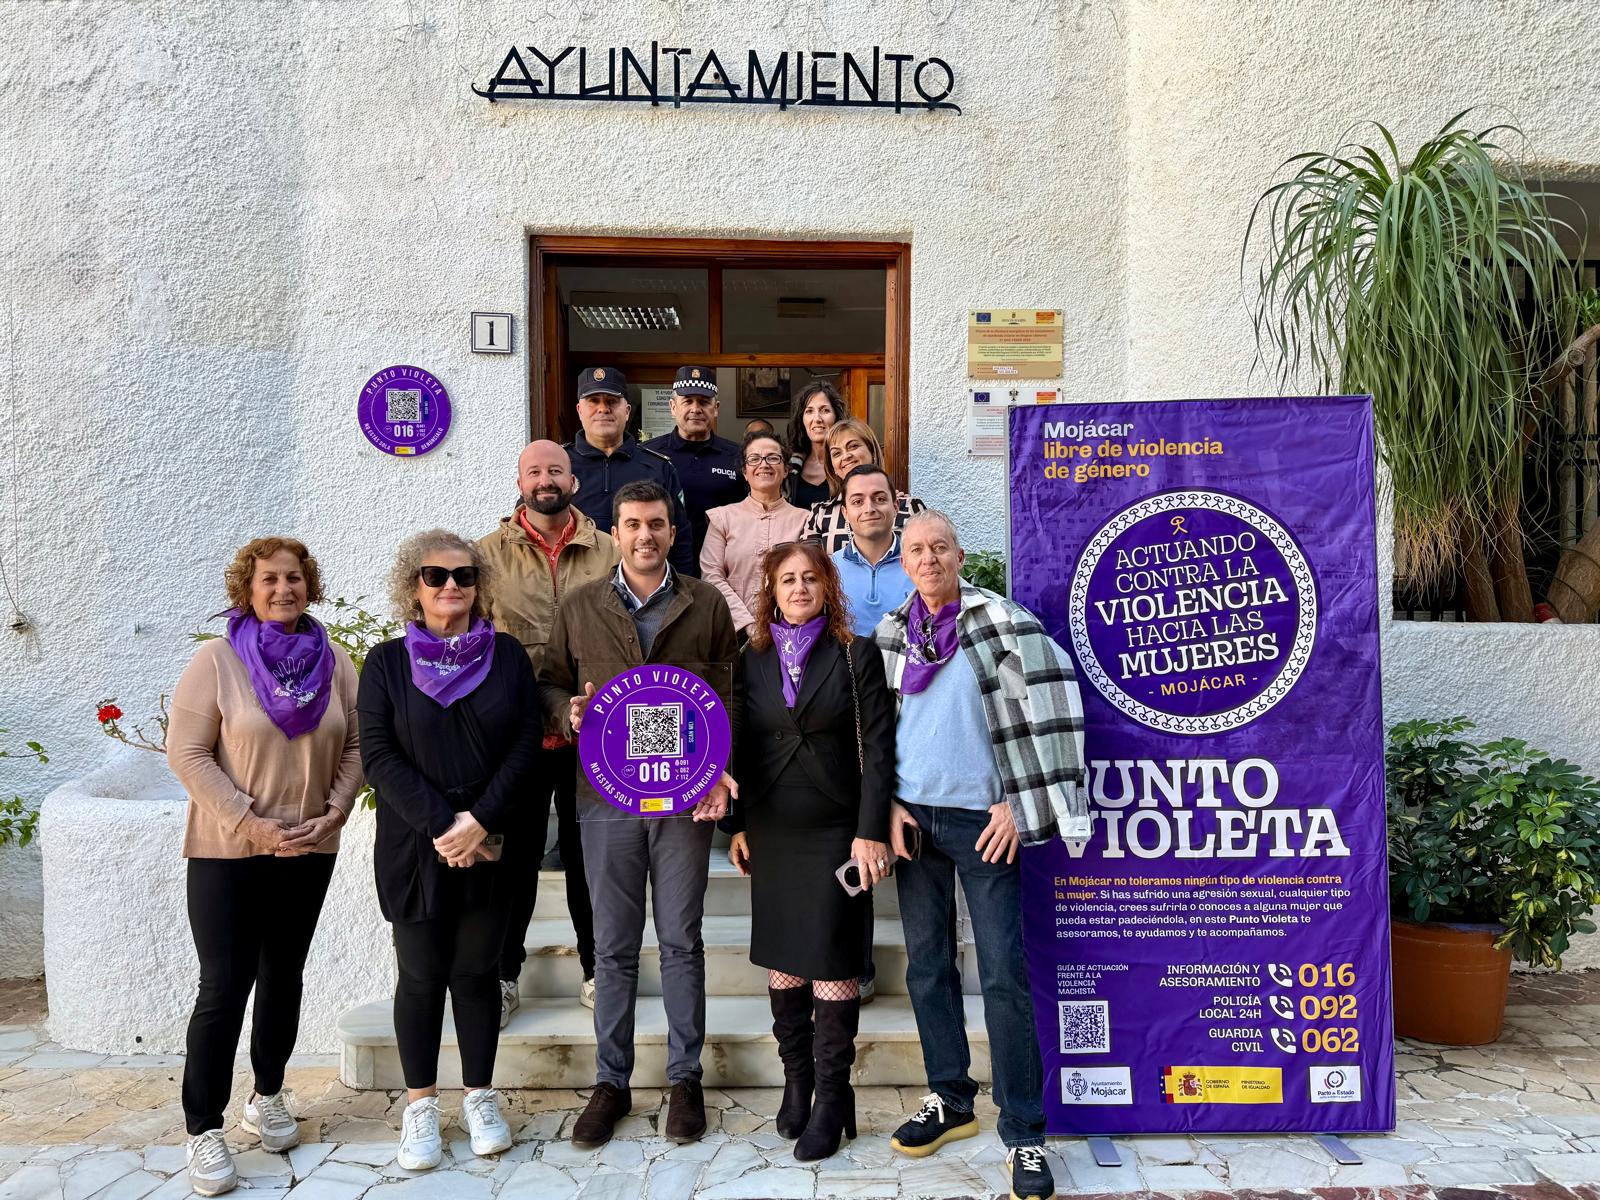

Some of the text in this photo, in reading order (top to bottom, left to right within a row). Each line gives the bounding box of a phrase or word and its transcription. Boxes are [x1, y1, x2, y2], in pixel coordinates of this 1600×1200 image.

[485, 41, 957, 112] AYUNTAMIENTO
[485, 321, 498, 346] 1
[366, 368, 442, 395] PUNTO VIOLETA
[394, 425, 414, 437] 016
[1044, 419, 1134, 441] Mojácar
[379, 440, 391, 451] SOLA
[1044, 437, 1223, 458] libre de violencia
[1044, 460, 1150, 483] de género
[1115, 532, 1256, 570] ACTUANDO
[1116, 556, 1260, 593] CONTRA LA
[1095, 577, 1288, 626] VIOLENCIA
[1126, 610, 1264, 648] HACIA LAS
[1118, 632, 1280, 679] MUJERES
[593, 670, 716, 714] PUNTO VIOLETA
[639, 761, 670, 782] 016
[590, 762, 599, 774] NO
[596, 774, 616, 795] ESTÁS
[614, 791, 633, 807] SOLA
[682, 763, 717, 803] DENÚNCIALO
[1085, 758, 1279, 808] UNTO
[1055, 877, 1066, 885] En
[1069, 876, 1111, 887] Mojácar
[1129, 876, 1181, 885] toleramos
[1184, 876, 1217, 886] ningún
[1220, 875, 1239, 886] tipo
[1242, 875, 1255, 884] de
[1257, 875, 1304, 884] violencia
[1307, 875, 1342, 884] contra
[1055, 890, 1064, 899] la
[1067, 890, 1098, 901] mujer.
[1100, 890, 1110, 899] Si
[1112, 890, 1130, 899] has
[1133, 890, 1169, 899] sufrido
[1193, 889, 1237, 899] agresión
[1240, 889, 1277, 898] sexual,
[1279, 888, 1328, 899] cualquier
[1330, 888, 1350, 898] tipo
[1056, 903, 1067, 911] de
[1070, 903, 1117, 912] violencia,
[1150, 903, 1187, 911] sufrirla
[1253, 901, 1287, 912] alguna
[1290, 901, 1320, 912] mujer
[1323, 902, 1343, 911] que
[1056, 916, 1086, 926] pueda
[1089, 916, 1115, 924] estar
[1119, 915, 1187, 926] padeciéndola,
[1205, 915, 1226, 923] este
[1229, 915, 1259, 923] Punto
[1262, 914, 1298, 923] Violeta
[1301, 914, 1311, 923] te
[1056, 927, 1287, 939] asesoramos, te ayudamos y te acompañamos.
[1057, 963, 1075, 971] GUÍA
[1087, 963, 1129, 971] ACTUACIÓN
[1167, 962, 1260, 974] INFORMACIÓN Y
[1298, 963, 1356, 988] 016
[1159, 977, 1260, 987] ASESORAMIENTO
[1213, 994, 1261, 1006] POLICÍA
[1300, 994, 1358, 1020] 092
[1199, 1008, 1262, 1019] LOCAL 24H
[1208, 1028, 1263, 1039] GUARDIA
[1302, 1027, 1359, 1053] 062
[1231, 1042, 1264, 1052] CIVIL
[1091, 1087, 1127, 1097] Mojácar
